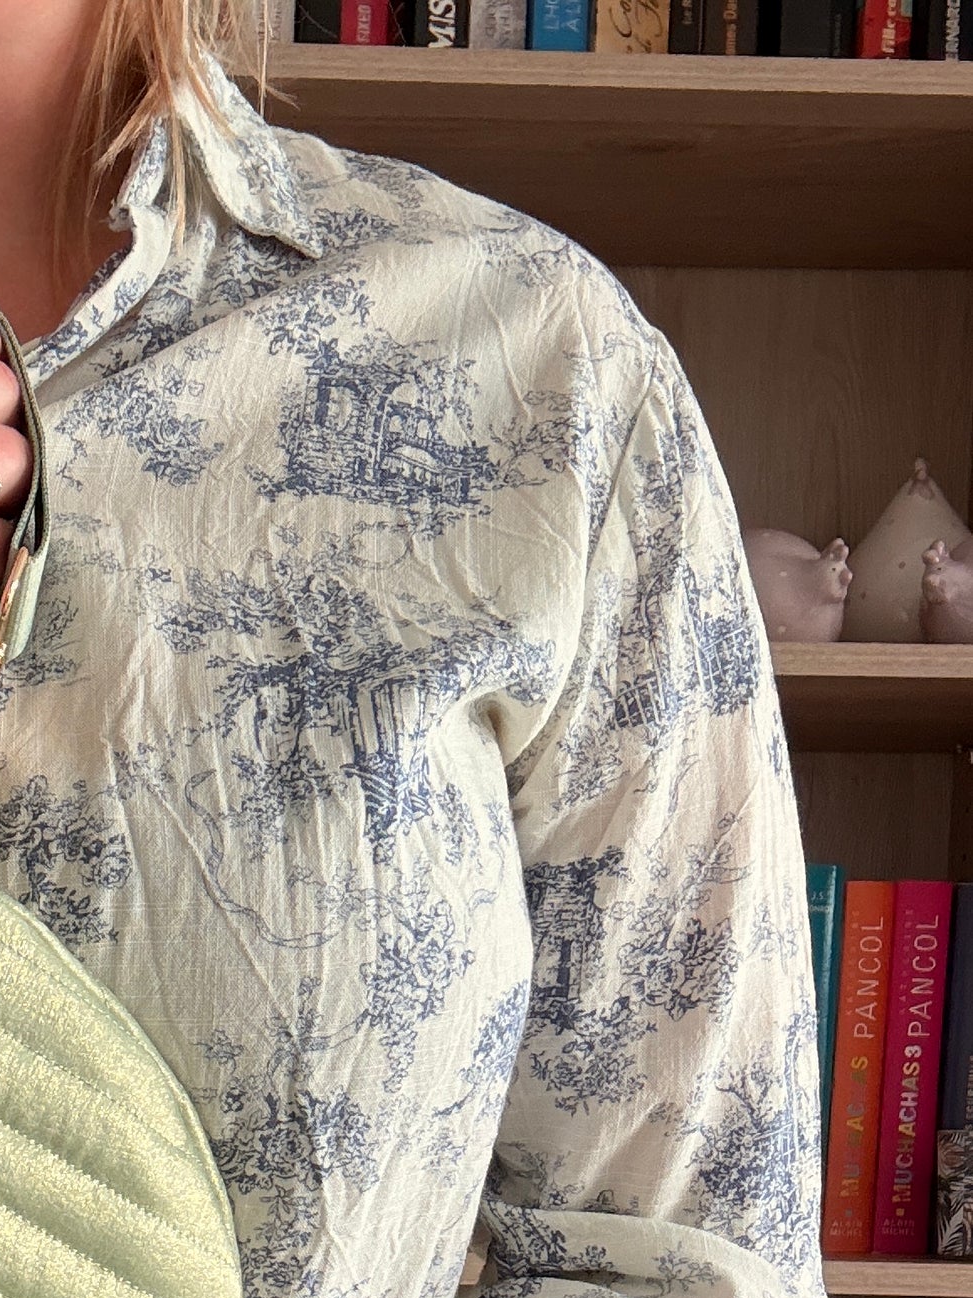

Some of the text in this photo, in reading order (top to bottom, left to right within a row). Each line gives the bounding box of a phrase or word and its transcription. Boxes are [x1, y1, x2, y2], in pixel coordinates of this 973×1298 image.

[853, 916, 884, 1038] PANCOL
[908, 915, 939, 1037] PANCOL
[892, 1063, 921, 1203] MUCHACHAS
